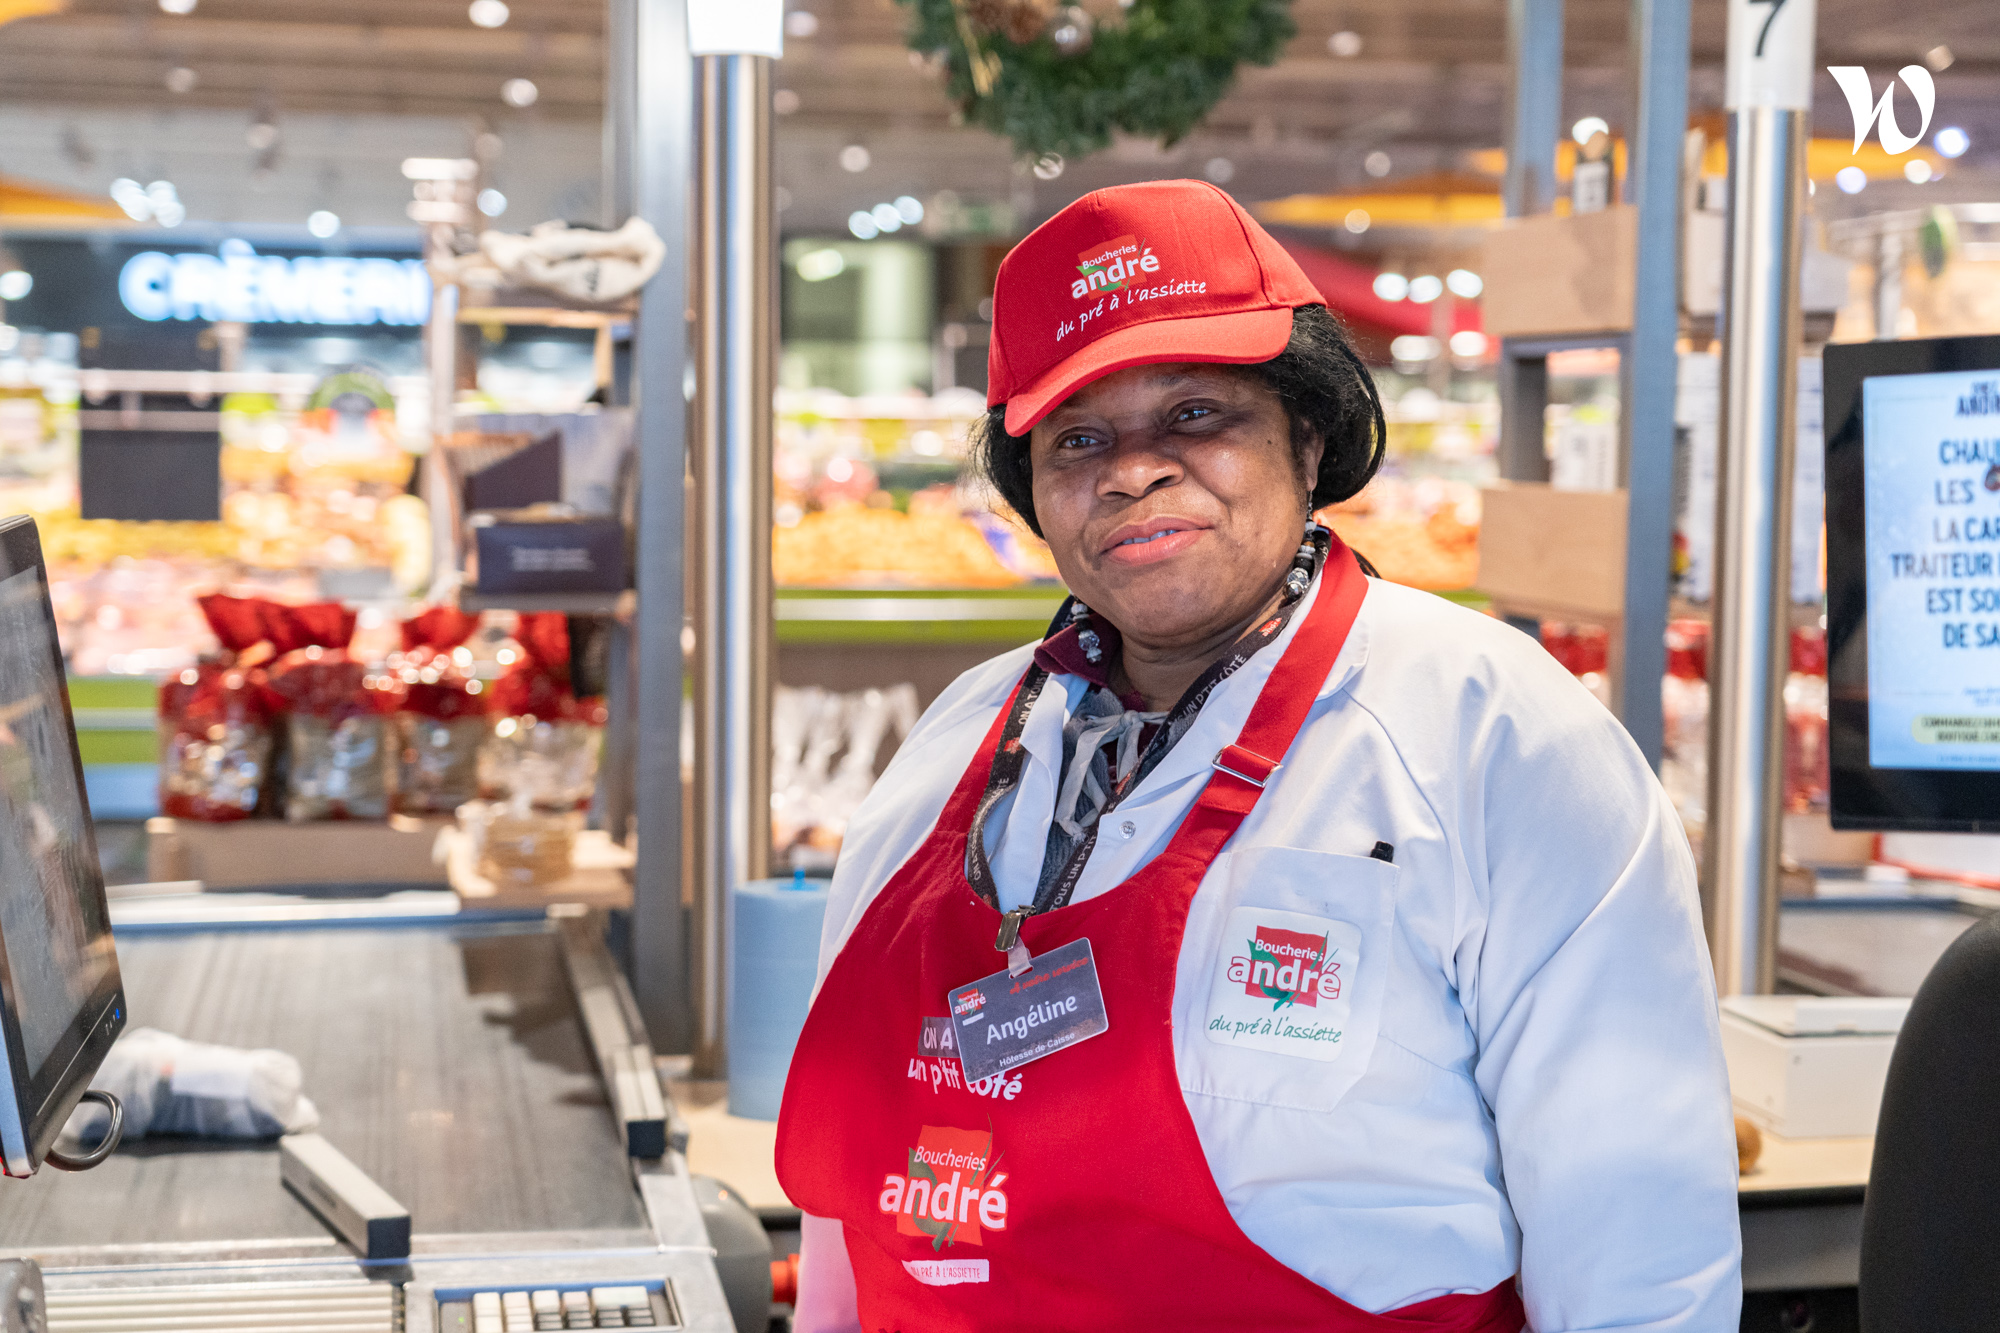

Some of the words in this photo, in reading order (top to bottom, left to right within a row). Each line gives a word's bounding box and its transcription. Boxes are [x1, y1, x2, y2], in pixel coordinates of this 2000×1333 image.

[1748, 0, 1787, 56] 7
[1082, 245, 1137, 270] Boucheries
[1071, 247, 1160, 299] andré
[1056, 321, 1075, 342] du
[1079, 298, 1104, 331] pré
[1109, 294, 1119, 311] à
[1127, 278, 1207, 305] l'assiette
[1935, 479, 1975, 505] LES
[1933, 518, 1960, 543] LA
[1891, 552, 1992, 578] TRAITEUR
[1926, 588, 1964, 614] EST
[1943, 622, 1969, 649] DE
[1219, 654, 1247, 680] CÔTÉ
[1018, 711, 1030, 725] ON
[1067, 863, 1081, 879] UN
[1255, 939, 1323, 962] Boucheries
[1227, 956, 1341, 999] andré
[955, 992, 987, 1014] andré
[986, 996, 1078, 1045] Angéline
[1209, 1015, 1232, 1031] du
[1233, 1017, 1263, 1039] pré
[1260, 1019, 1272, 1035] à
[1274, 1016, 1342, 1043] l'assiette
[923, 1027, 937, 1049] ON
[940, 1027, 953, 1050] A
[1000, 1049, 1033, 1067] Hôtesse
[1035, 1043, 1046, 1054] de
[1047, 1032, 1075, 1048] Caisse
[907, 1058, 927, 1082] un
[914, 1145, 986, 1171] Boucheries
[879, 1171, 1007, 1229] andré
